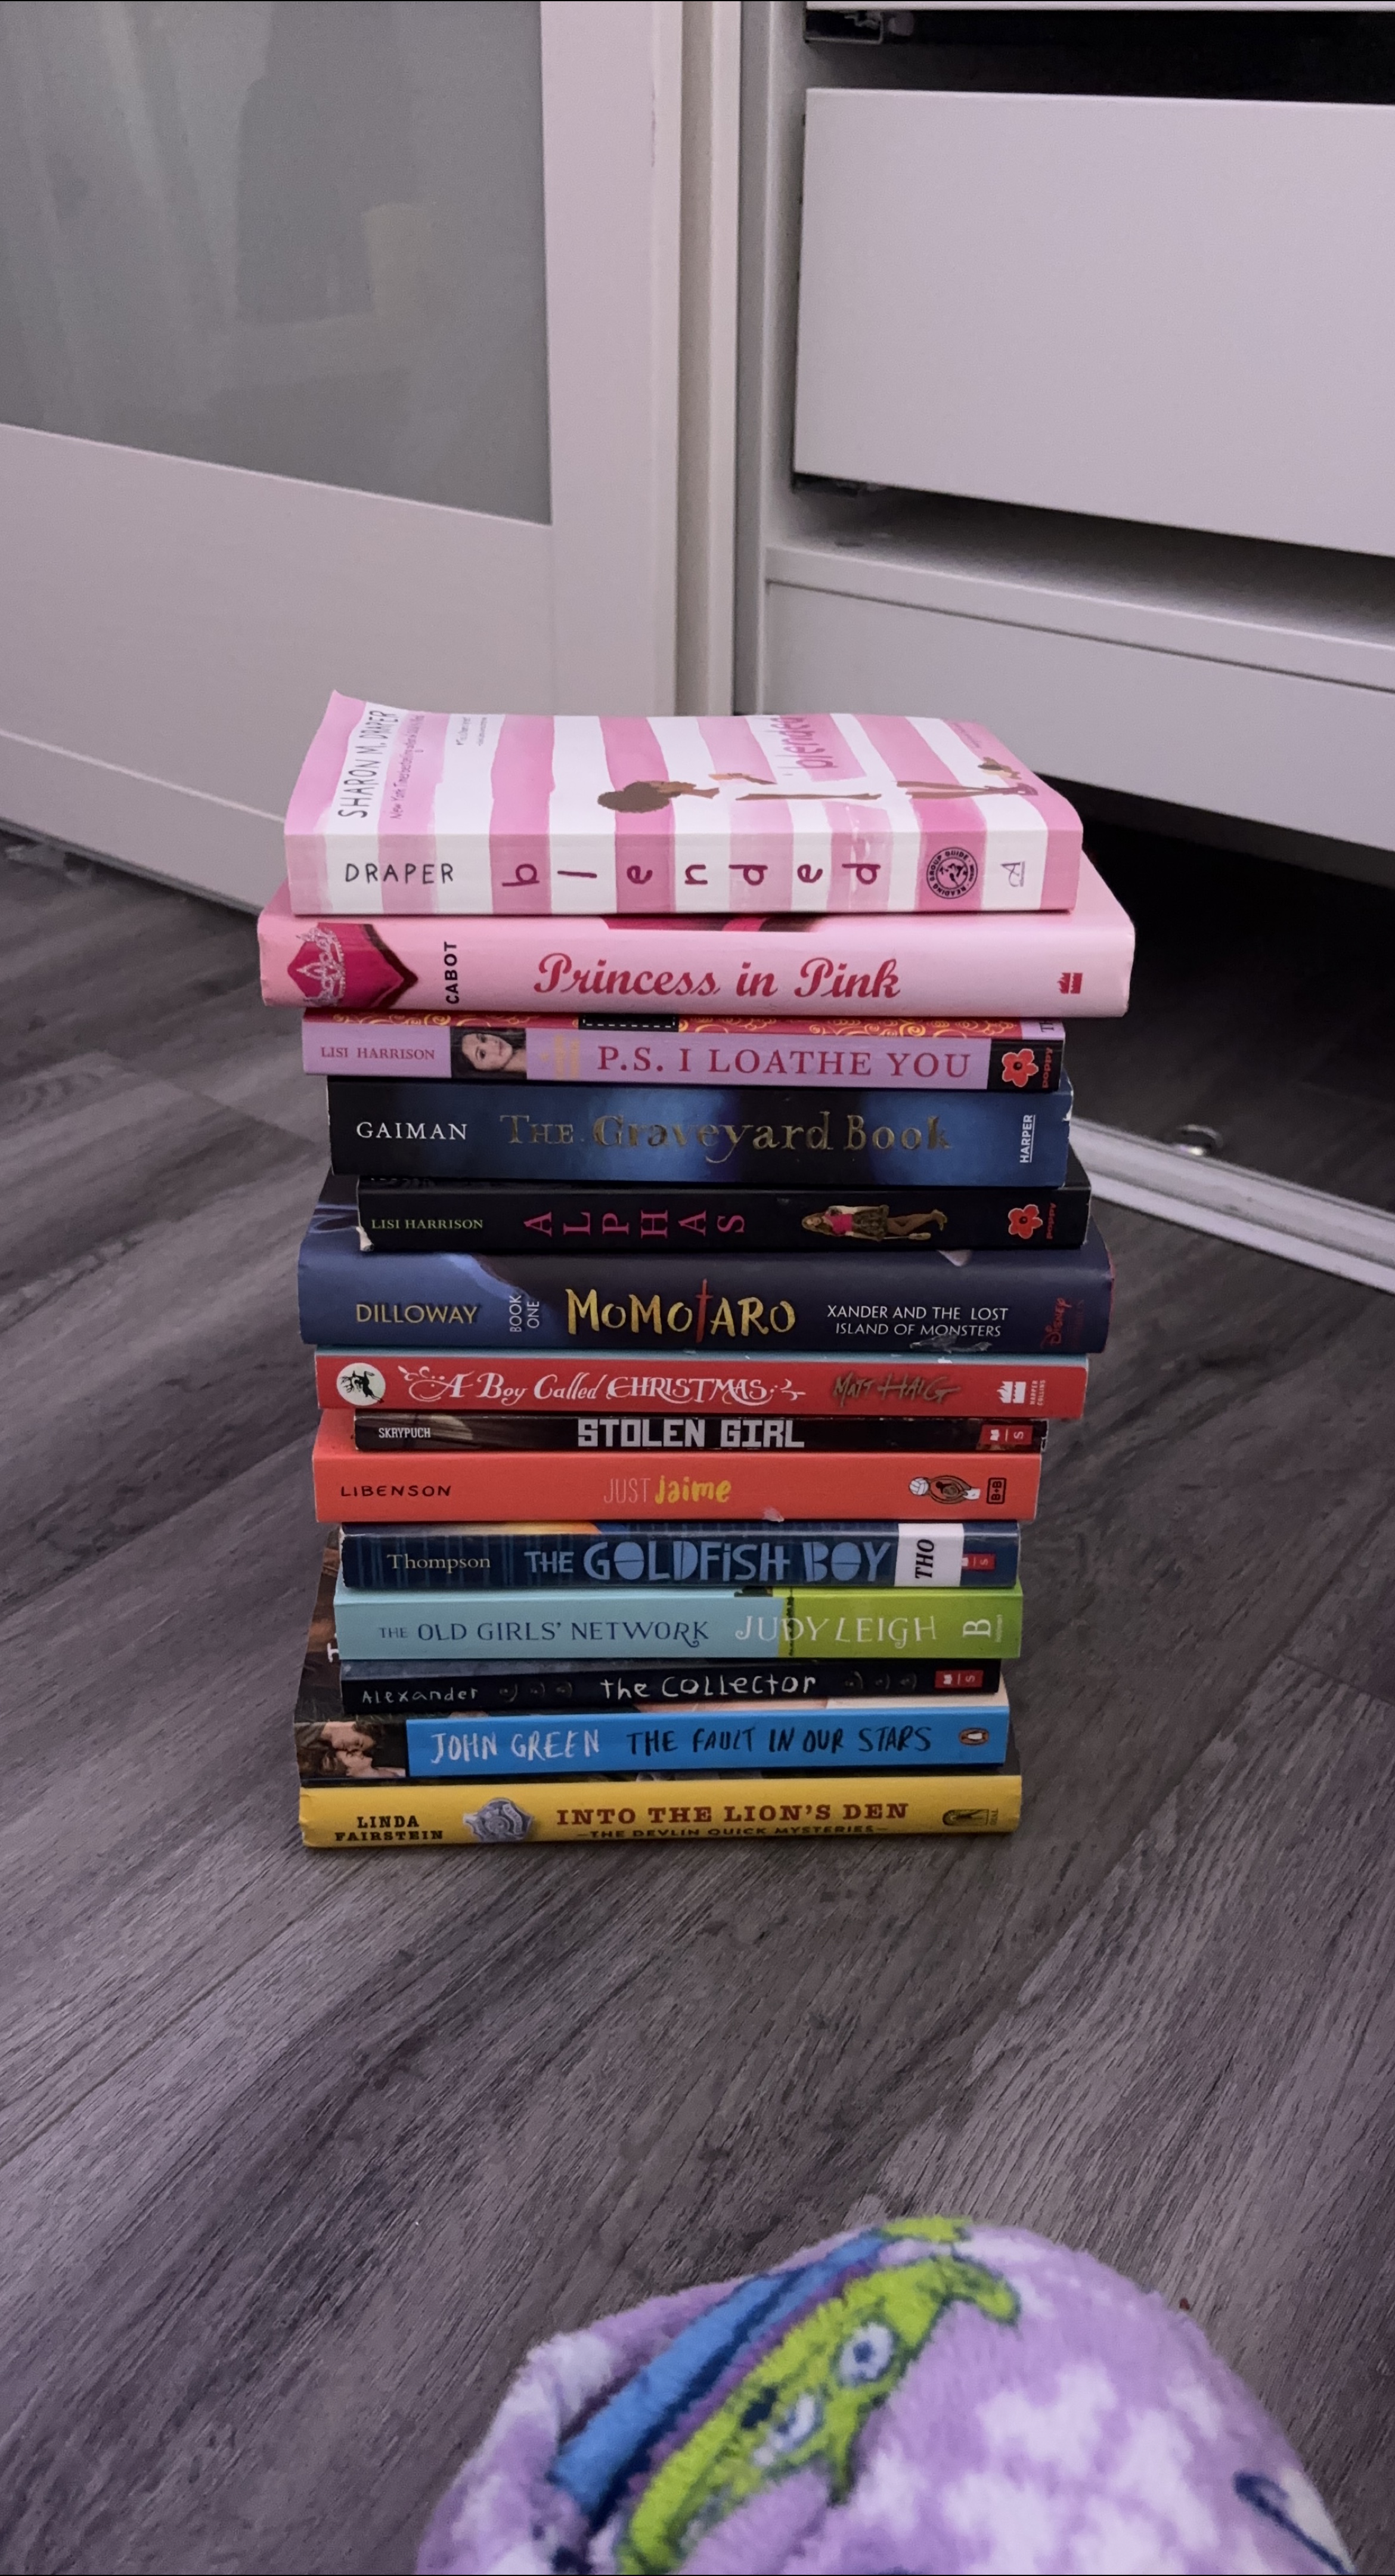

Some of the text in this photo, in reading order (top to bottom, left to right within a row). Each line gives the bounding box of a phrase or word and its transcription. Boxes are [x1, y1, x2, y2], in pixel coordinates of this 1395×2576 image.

[337, 710, 399, 819] SHARON M. DRAPER
[390, 804, 404, 819] New
[345, 863, 454, 884] DRAPER
[929, 854, 942, 881] GROUP
[945, 850, 969, 861] GUIDE
[444, 942, 460, 1004] CABOT
[534, 953, 901, 998] Princess in Pink
[320, 1046, 435, 1060] LISI HARRISON
[597, 1045, 664, 1071] P.S.
[678, 1048, 692, 1072] I
[708, 1048, 871, 1075] LOATHE
[886, 1052, 971, 1078] YOU
[1041, 1046, 1053, 1089] poppy
[356, 1121, 468, 1140] GAIMAN
[593, 1110, 834, 1163] Graveyard
[844, 1114, 952, 1150] Book
[1019, 1114, 1034, 1163] HARPER
[371, 1219, 483, 1230] LISI HARRISON
[1046, 1203, 1057, 1240] poppy
[356, 1304, 478, 1324] DILLOWAY
[509, 1295, 522, 1333] BOOK
[526, 1301, 540, 1329] ONE
[827, 1305, 1009, 1321] XANDER AND THE LOST
[835, 1323, 1002, 1337] ISLAND OF MONSTERS
[405, 1370, 774, 1406] A Boy Called CHRISTMAS
[1030, 1380, 1038, 1405] HARPER
[1037, 1379, 1046, 1405] COLLINS
[379, 1427, 431, 1438] SKRYPUCH
[578, 1419, 805, 1448] STOLEN GIRL
[340, 1485, 452, 1497] LIBENSON
[603, 1478, 651, 1504] JUST
[387, 1553, 491, 1574] Thompson
[524, 1541, 891, 1582] THE GOLDFISH BOY
[914, 1539, 935, 1579] THO
[379, 1626, 408, 1639] THE
[417, 1623, 467, 1641] OLD
[571, 1621, 709, 1648] NETWORK
[735, 1615, 936, 1649] JUDY LEIGH
[361, 1686, 478, 1704] Alexander
[600, 1677, 650, 1701] the
[430, 1729, 600, 1763] JOHN GREEN
[627, 1726, 931, 1756] THE FAULT IN OUR STARS
[358, 1815, 419, 1829] LINDA
[557, 1803, 909, 1825] INTO THE LION'S DEN
[335, 1831, 443, 1841] FAIRSTEIN
[633, 1829, 700, 1838] DEVLIN
[708, 1828, 767, 1836] QUICK
